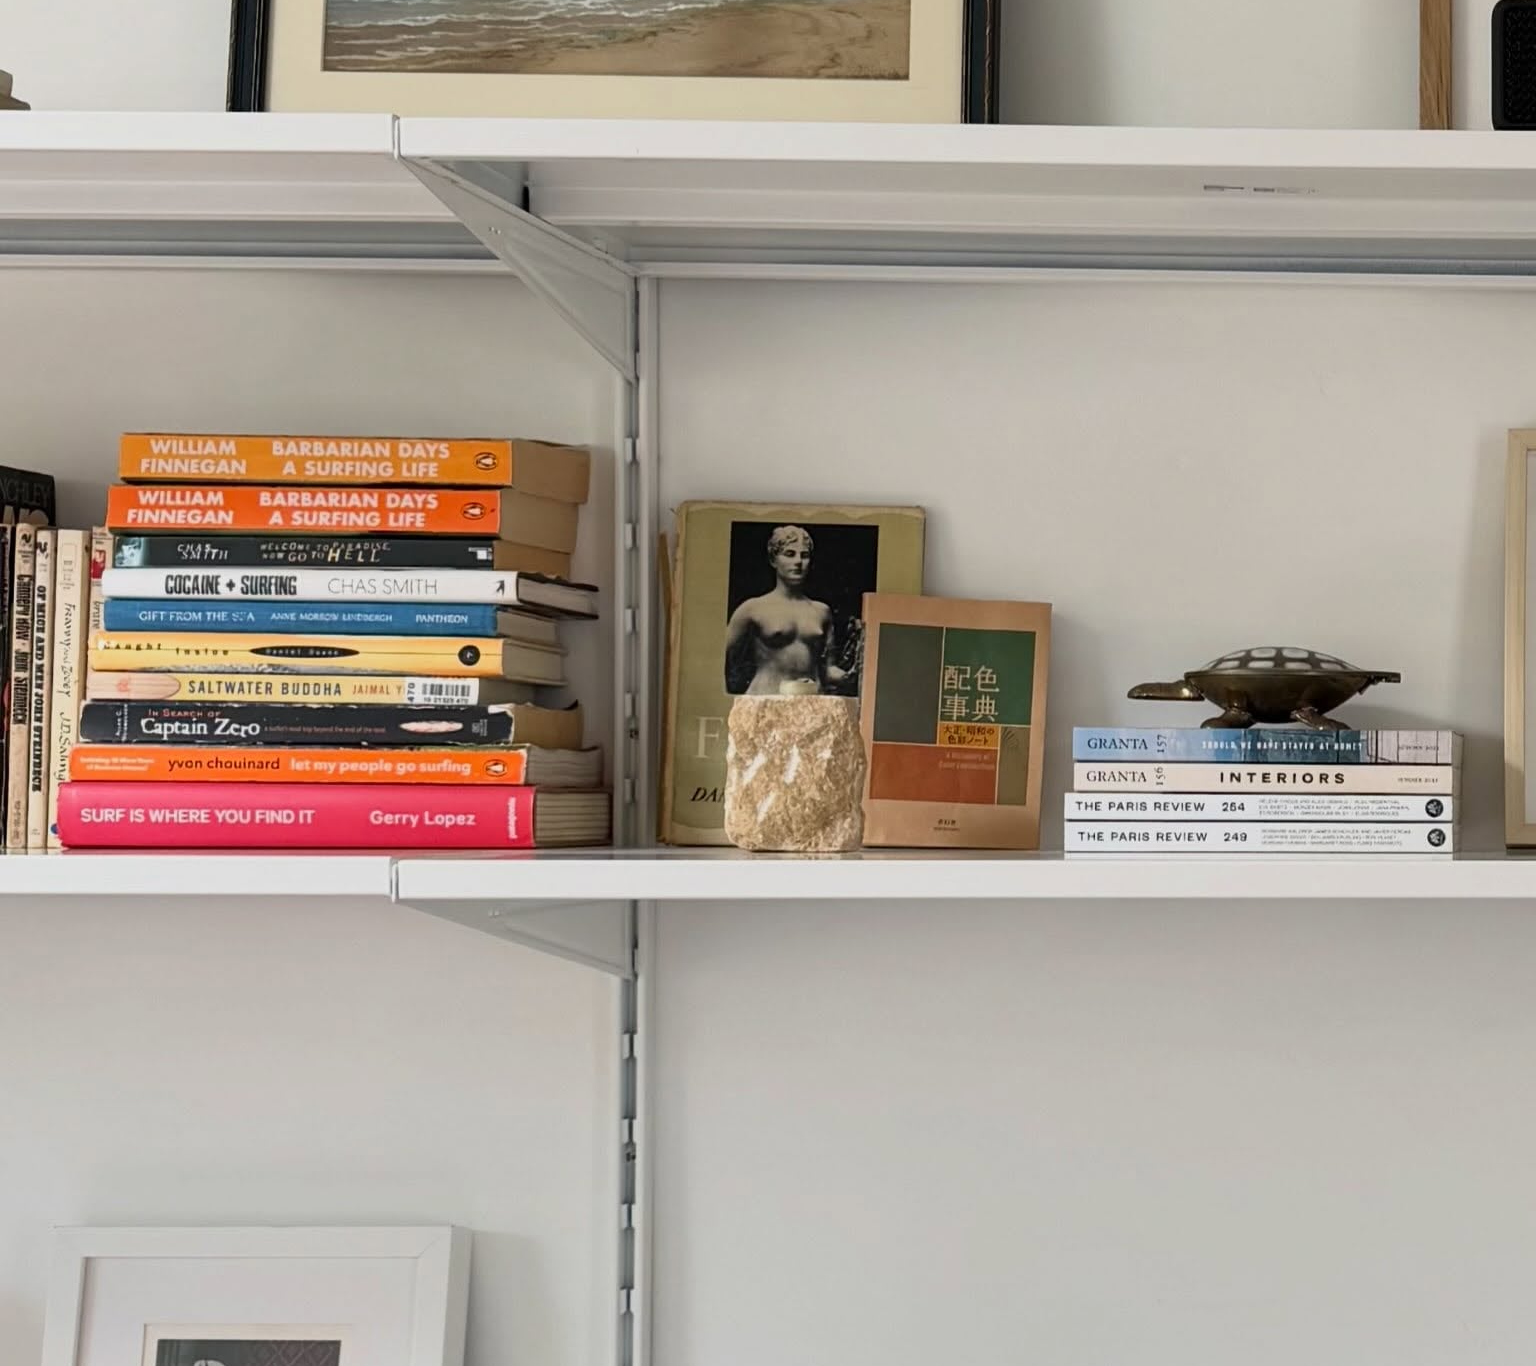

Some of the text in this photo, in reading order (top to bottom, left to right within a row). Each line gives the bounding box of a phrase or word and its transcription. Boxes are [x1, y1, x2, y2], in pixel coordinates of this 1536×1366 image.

[140, 439, 246, 475] WILLIAM FINNEGAN
[272, 441, 450, 459] BARBARIAN DAYS
[284, 461, 438, 477] A SURFING LIFE
[127, 490, 233, 525] WILLIAM FINNEGAN
[260, 493, 438, 509] BARBARIAN DAYS
[270, 511, 426, 527] A SURFING LIFE
[165, 575, 221, 594] COCAINE
[241, 575, 297, 595] SURFING
[328, 578, 438, 595] CHAS SMITH
[189, 680, 342, 696] SALTWATER BUDDHA
[141, 719, 207, 735] Captain
[214, 719, 260, 737] Zero
[1088, 738, 1148, 749] GRANTA
[168, 759, 202, 771] yvon
[207, 756, 280, 770] chouinard
[290, 758, 471, 776] let my people go surfing
[1087, 771, 1146, 782] GRANTA
[1220, 772, 1345, 785] INTERIORS
[1076, 802, 1205, 811] THE PARIS REVIEW
[81, 809, 315, 823] SURF IS WHERE YOU FIND IT
[370, 811, 475, 828] Gerry Lopez
[1078, 832, 1207, 841] THE PARIS REVIEW
